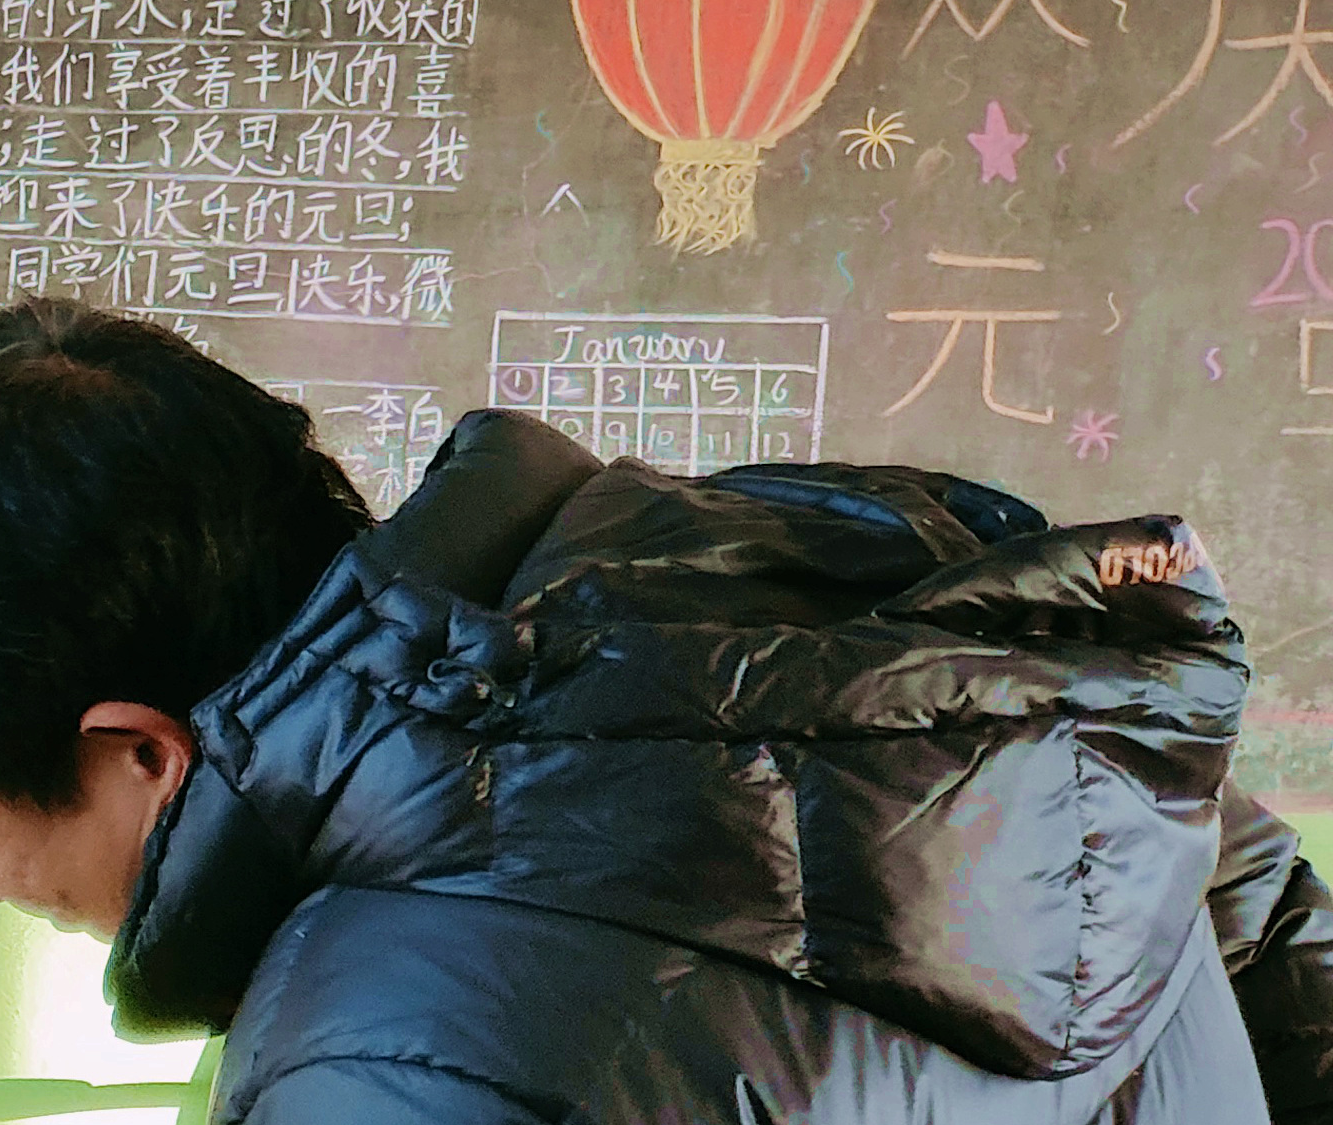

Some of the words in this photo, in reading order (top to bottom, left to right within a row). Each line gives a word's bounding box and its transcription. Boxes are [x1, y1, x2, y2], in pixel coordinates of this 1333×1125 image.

[607, 375, 627, 404] 3
[653, 370, 681, 400] 4
[770, 373, 789, 404] 6
[647, 424, 676, 454] 10
[708, 432, 732, 456] 11
[763, 432, 795, 459] 12
